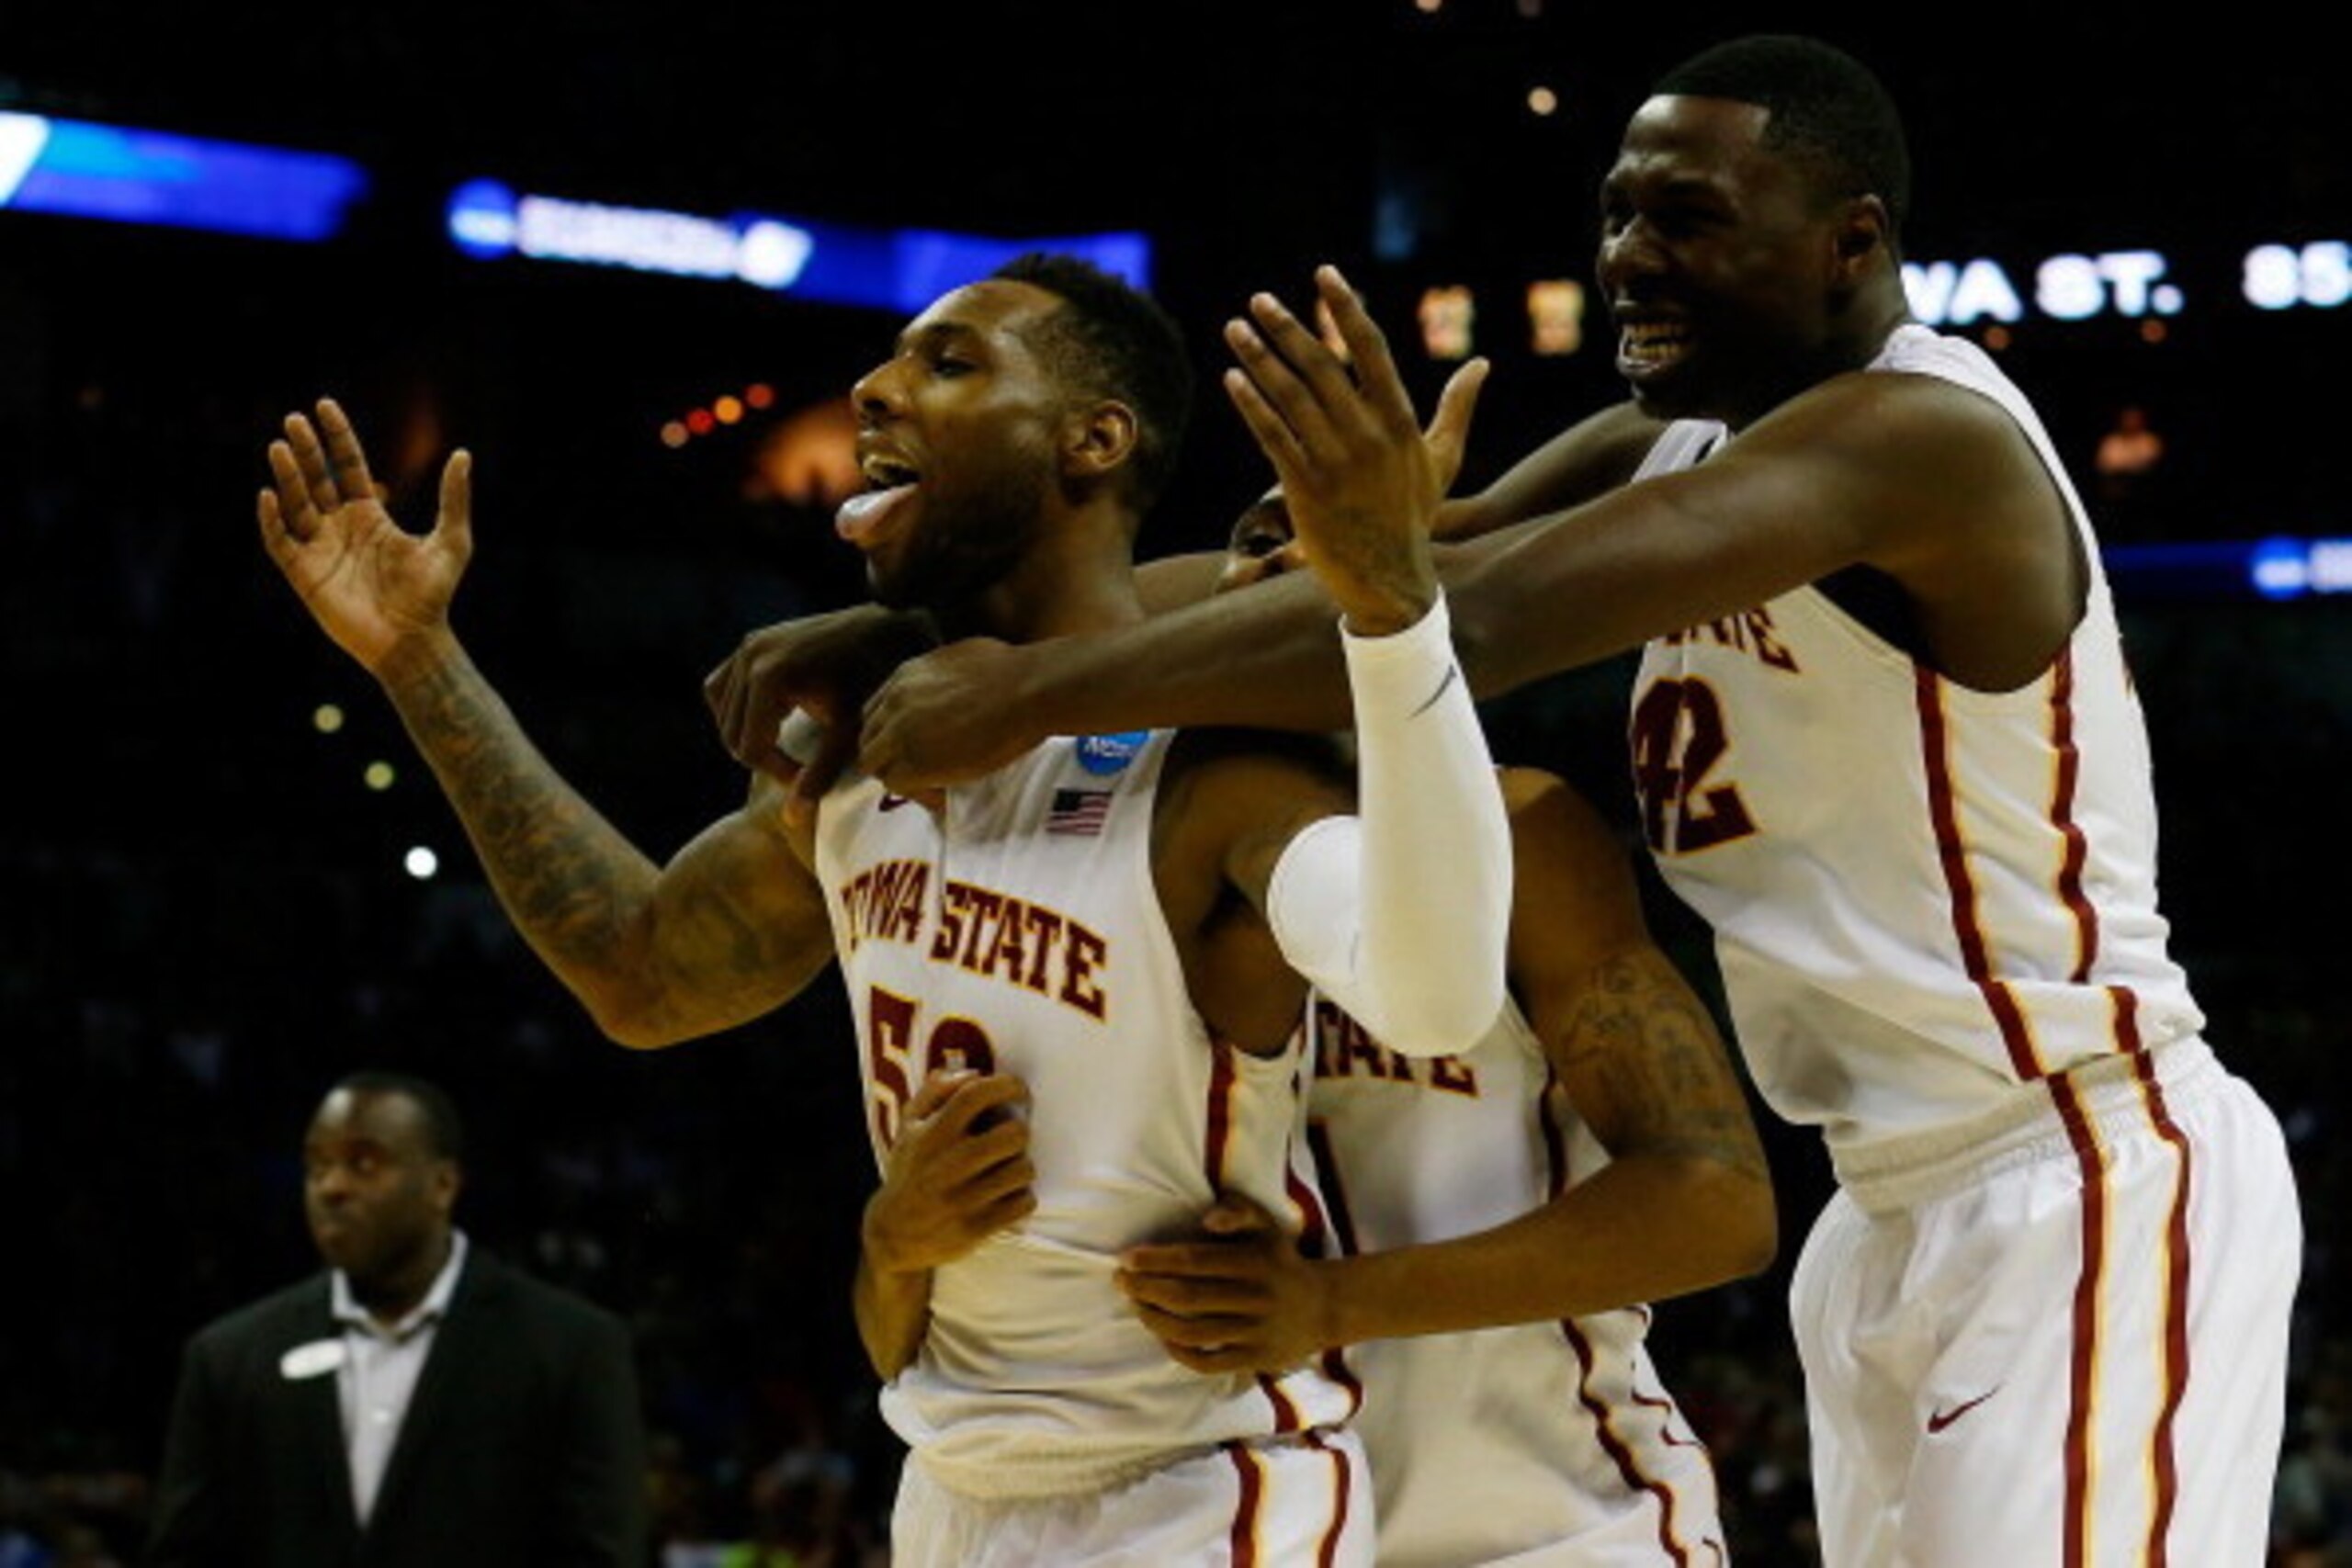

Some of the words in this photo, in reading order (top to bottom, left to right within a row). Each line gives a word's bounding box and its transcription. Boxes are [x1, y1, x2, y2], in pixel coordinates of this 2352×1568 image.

[2036, 251, 2184, 319] ST.
[1633, 676, 1758, 856] 42
[929, 880, 1106, 1024] STATE
